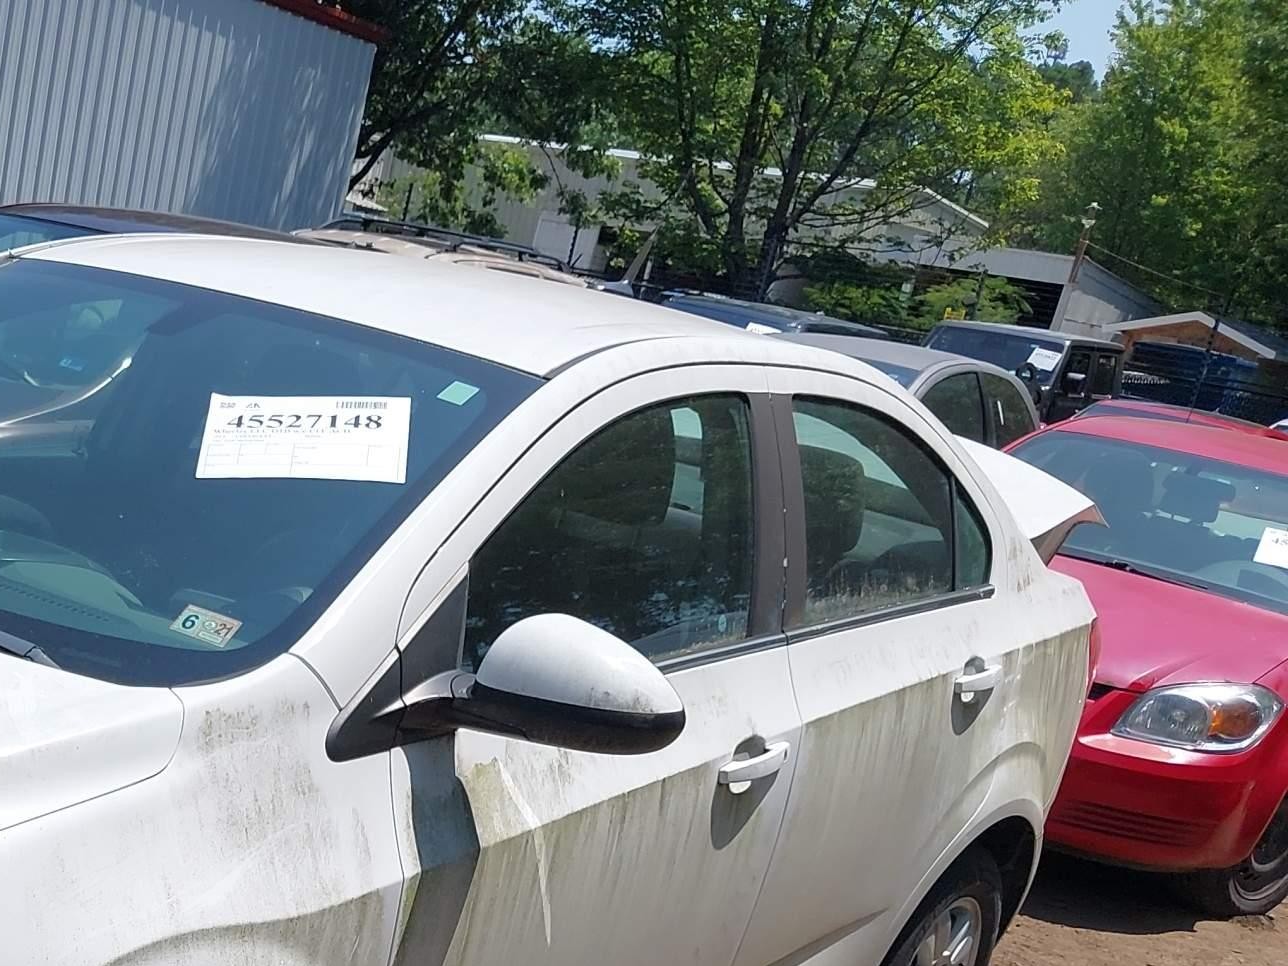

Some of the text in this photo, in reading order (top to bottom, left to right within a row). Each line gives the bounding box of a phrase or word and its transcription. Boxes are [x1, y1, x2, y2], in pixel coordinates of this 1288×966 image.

[227, 414, 383, 429] 45527148
[181, 614, 234, 638] 6 21
